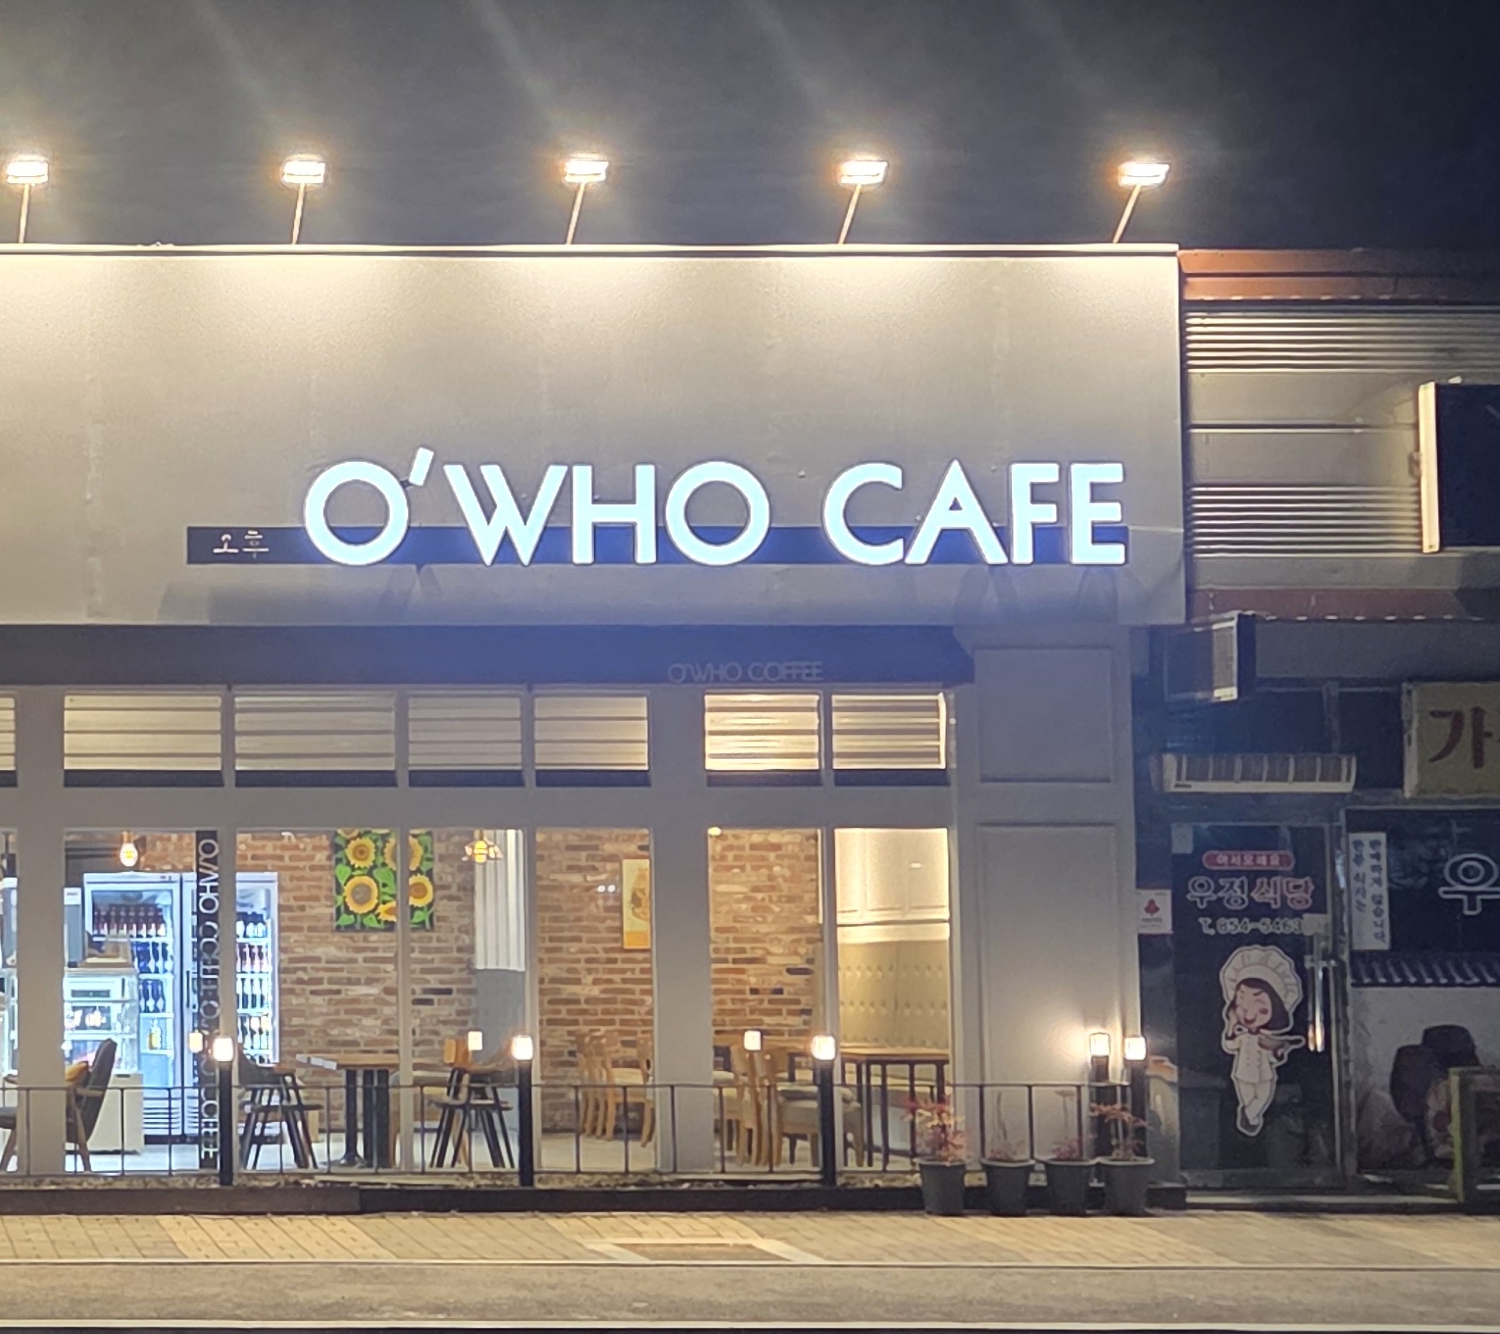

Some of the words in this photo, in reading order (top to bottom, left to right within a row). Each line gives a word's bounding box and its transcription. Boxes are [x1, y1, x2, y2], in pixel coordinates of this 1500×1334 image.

[303, 447, 770, 566] O'WHO
[822, 459, 1126, 565] CAFE
[747, 661, 824, 681] COFFEE
